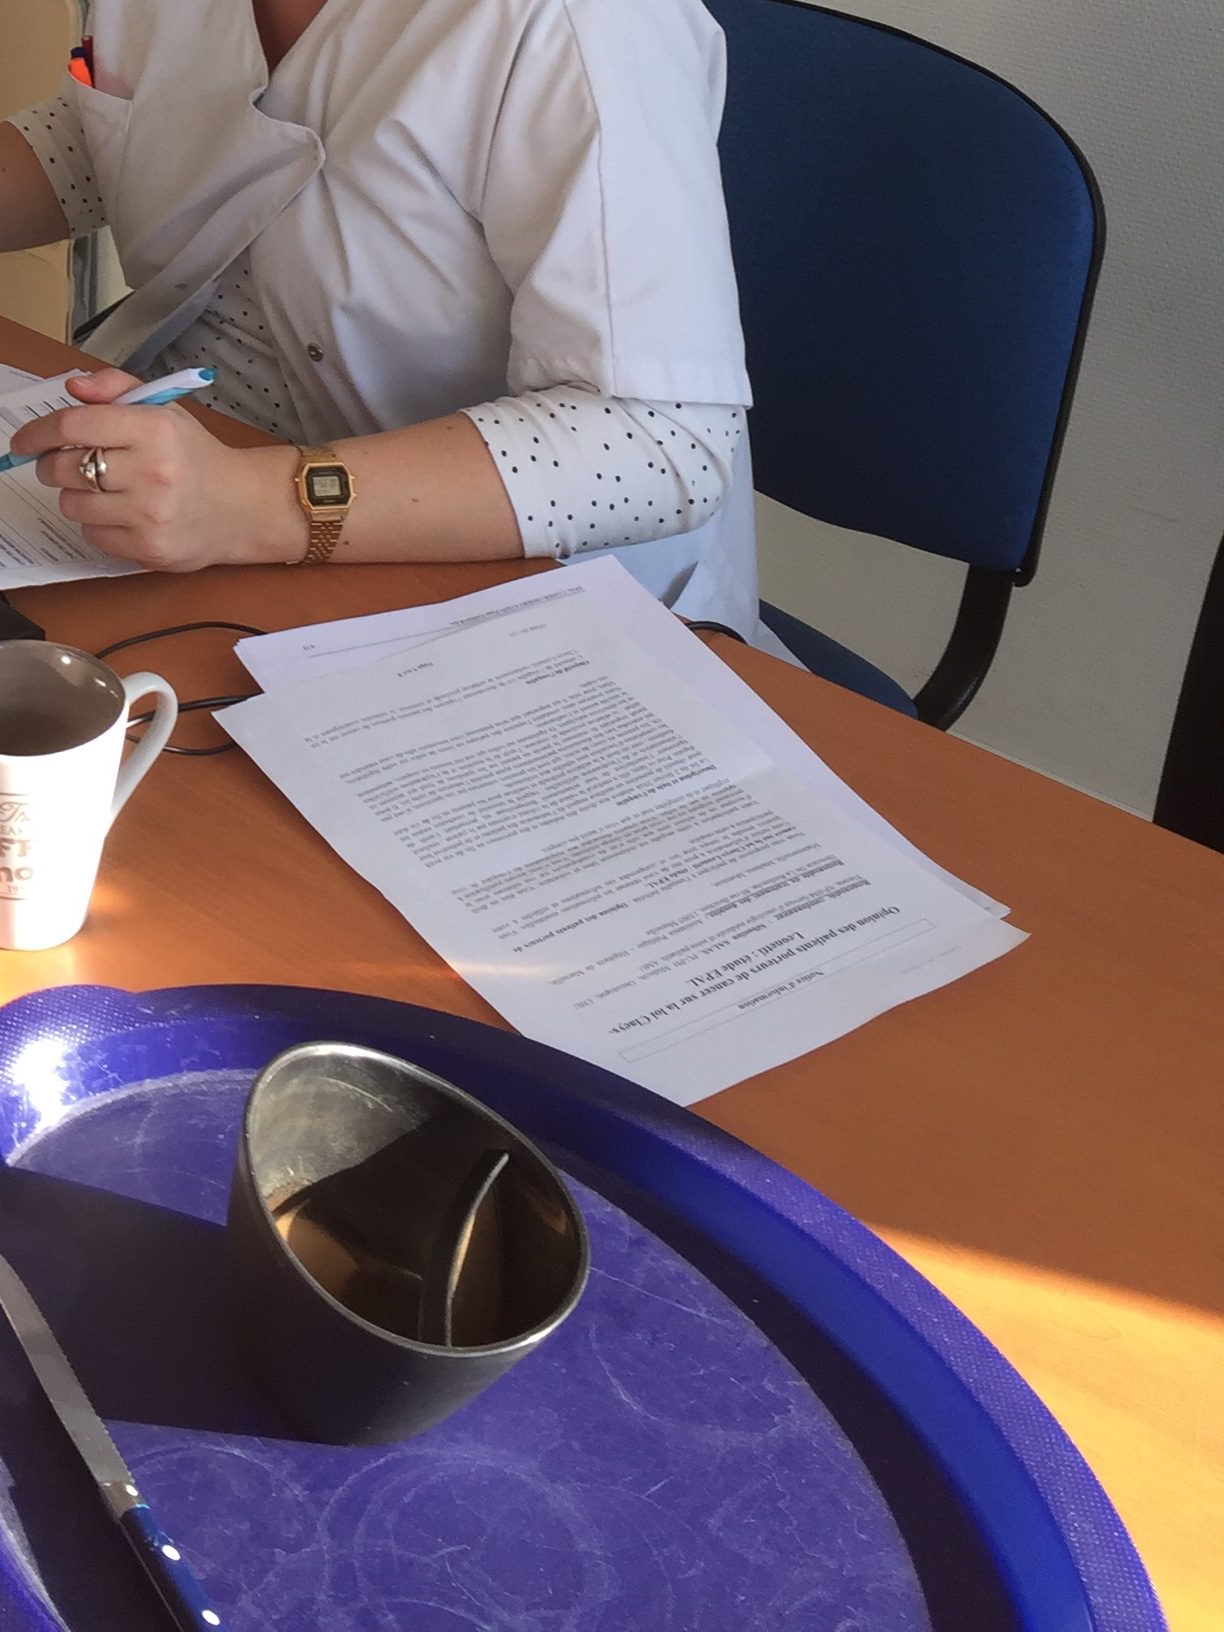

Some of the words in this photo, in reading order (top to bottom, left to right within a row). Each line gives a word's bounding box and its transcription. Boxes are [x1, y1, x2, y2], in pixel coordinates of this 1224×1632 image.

[855, 903, 901, 929] Opinion
[837, 922, 858, 937] des
[755, 930, 805, 957] Leonetti
[792, 929, 840, 956] patients
[719, 953, 754, 974] étude
[747, 947, 798, 976] porteurs
[685, 967, 723, 990] EPAL
[733, 970, 752, 984] de
[698, 977, 735, 999] cancer
[665, 1001, 681, 1014] la
[678, 993, 700, 1007] sur
[649, 1007, 668, 1021] loi
